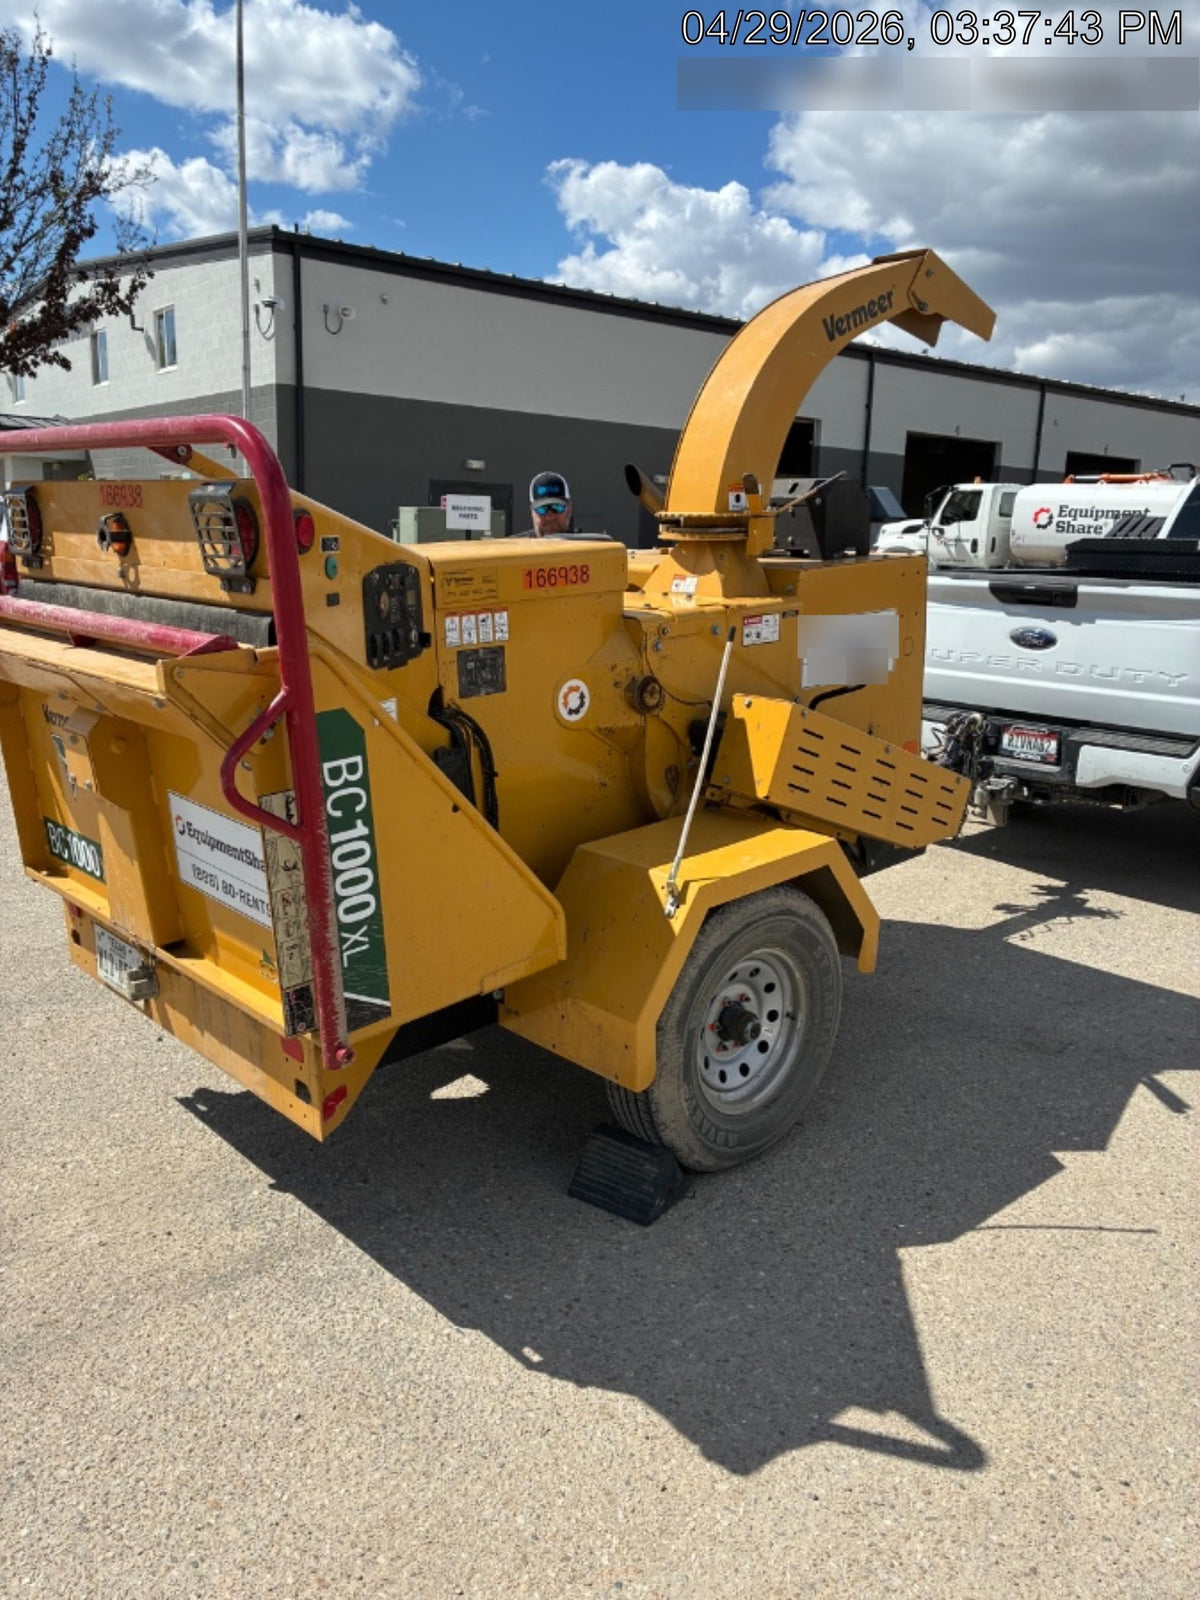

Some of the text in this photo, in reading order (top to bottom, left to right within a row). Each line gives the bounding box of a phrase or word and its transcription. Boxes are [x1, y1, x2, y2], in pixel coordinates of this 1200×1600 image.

[822, 289, 894, 342] Vermeer
[1055, 520, 1103, 535] Share
[1057, 504, 1151, 521] Equipment
[525, 564, 590, 589] 166938
[931, 648, 1188, 688] UPER DUTY
[47, 822, 101, 877] BC 1000
[186, 821, 266, 872] EquipmentSha
[323, 755, 377, 968] BC 1000 XL
